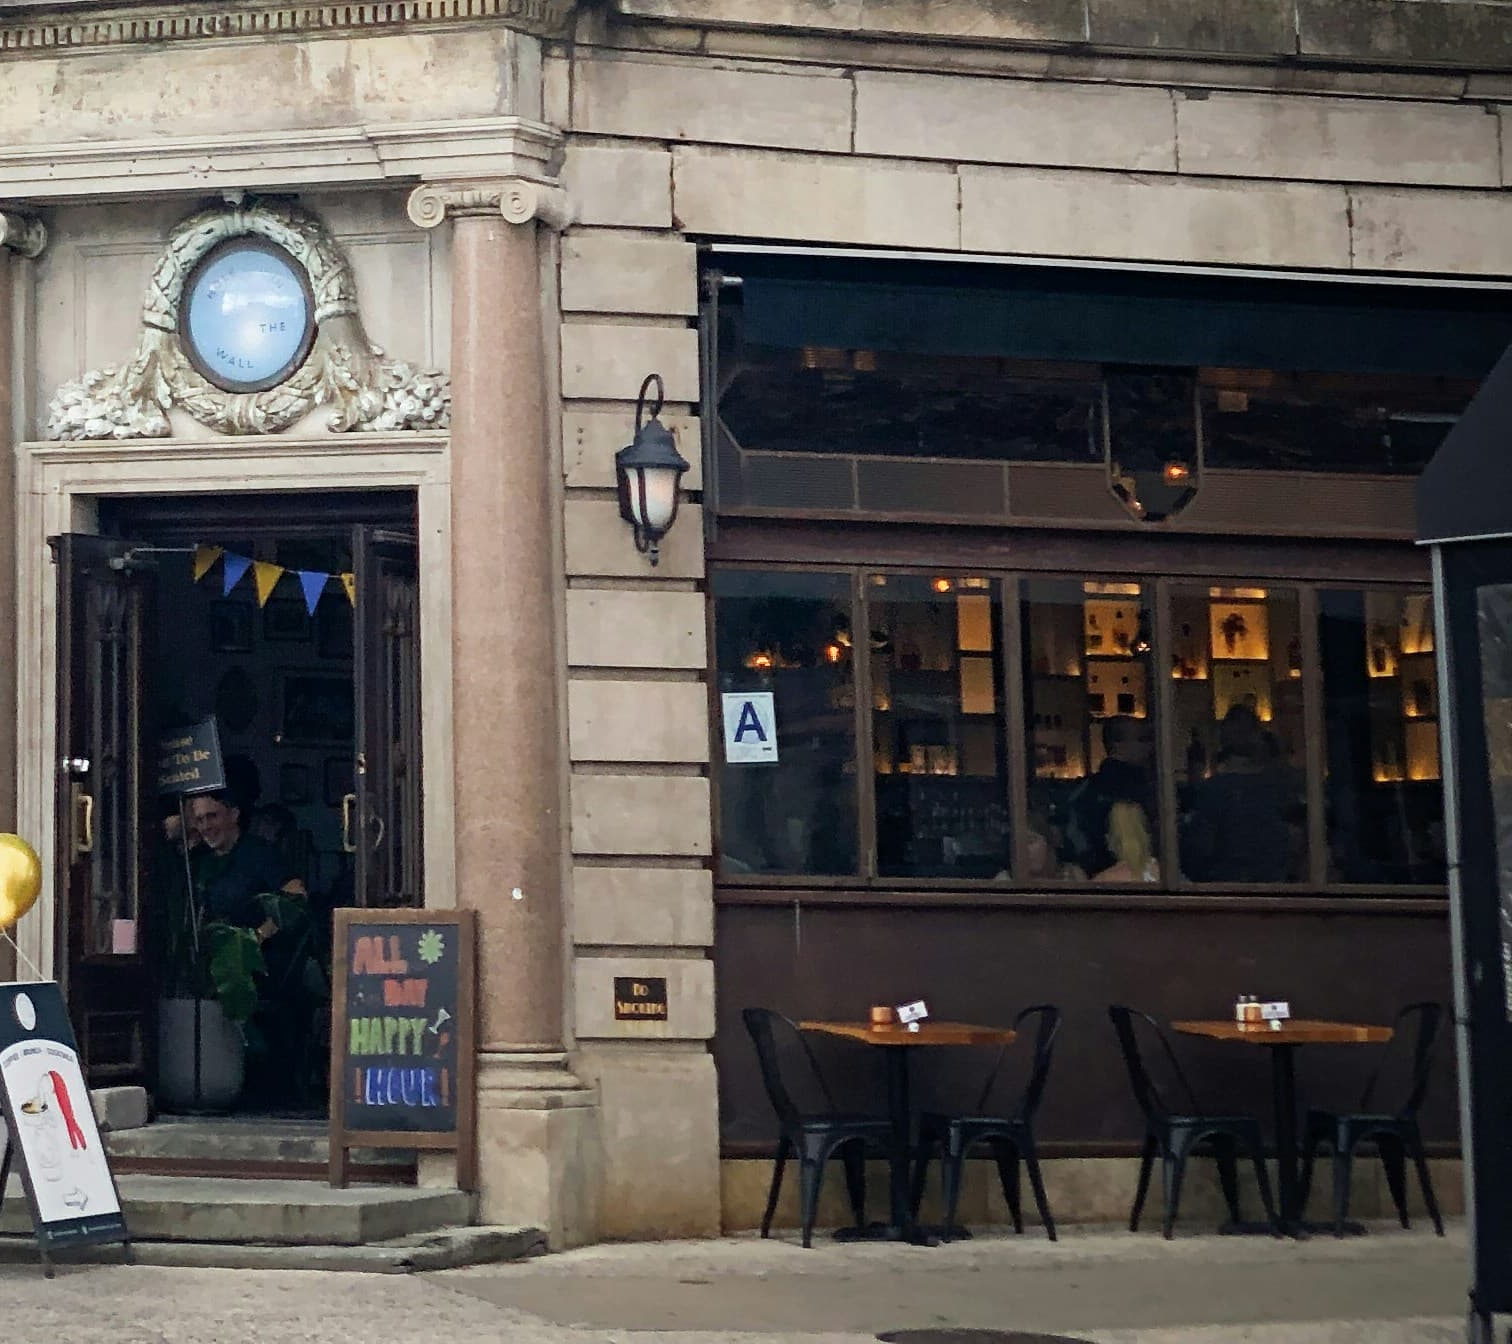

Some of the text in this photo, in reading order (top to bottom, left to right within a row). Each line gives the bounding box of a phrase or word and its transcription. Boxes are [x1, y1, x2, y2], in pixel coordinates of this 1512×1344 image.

[259, 321, 286, 333] THE
[216, 346, 254, 369] WALL
[734, 701, 768, 743] A
[352, 935, 409, 976] ALL
[349, 1016, 428, 1056] HAPPY
